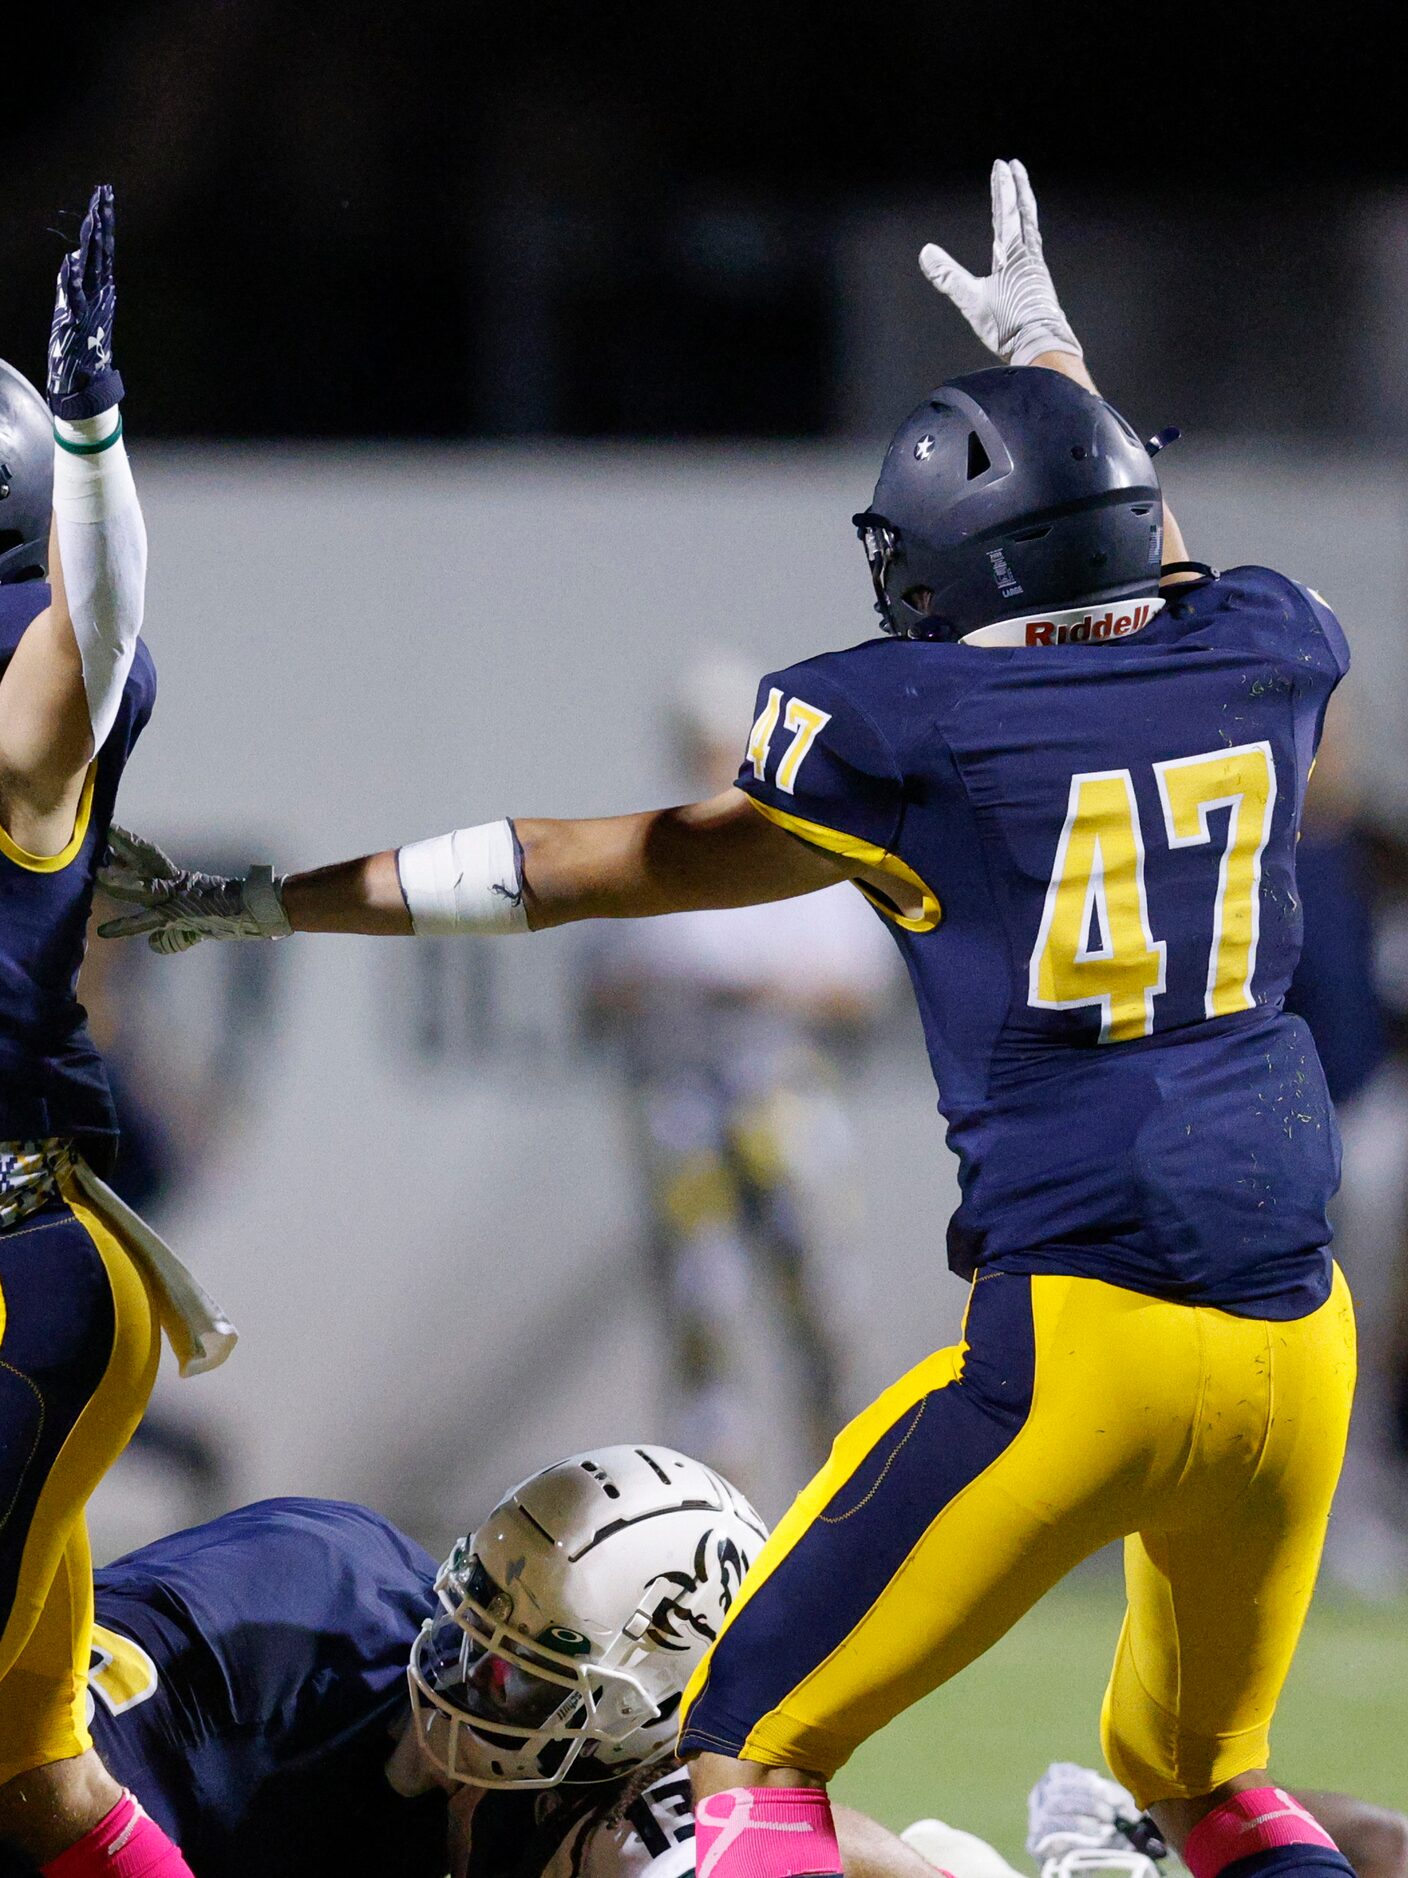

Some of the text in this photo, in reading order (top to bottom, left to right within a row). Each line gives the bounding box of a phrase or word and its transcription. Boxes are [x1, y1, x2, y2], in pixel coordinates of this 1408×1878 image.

[1024, 604, 1150, 646] Riddell
[746, 687, 832, 795] 47
[1027, 740, 1277, 1044] 47
